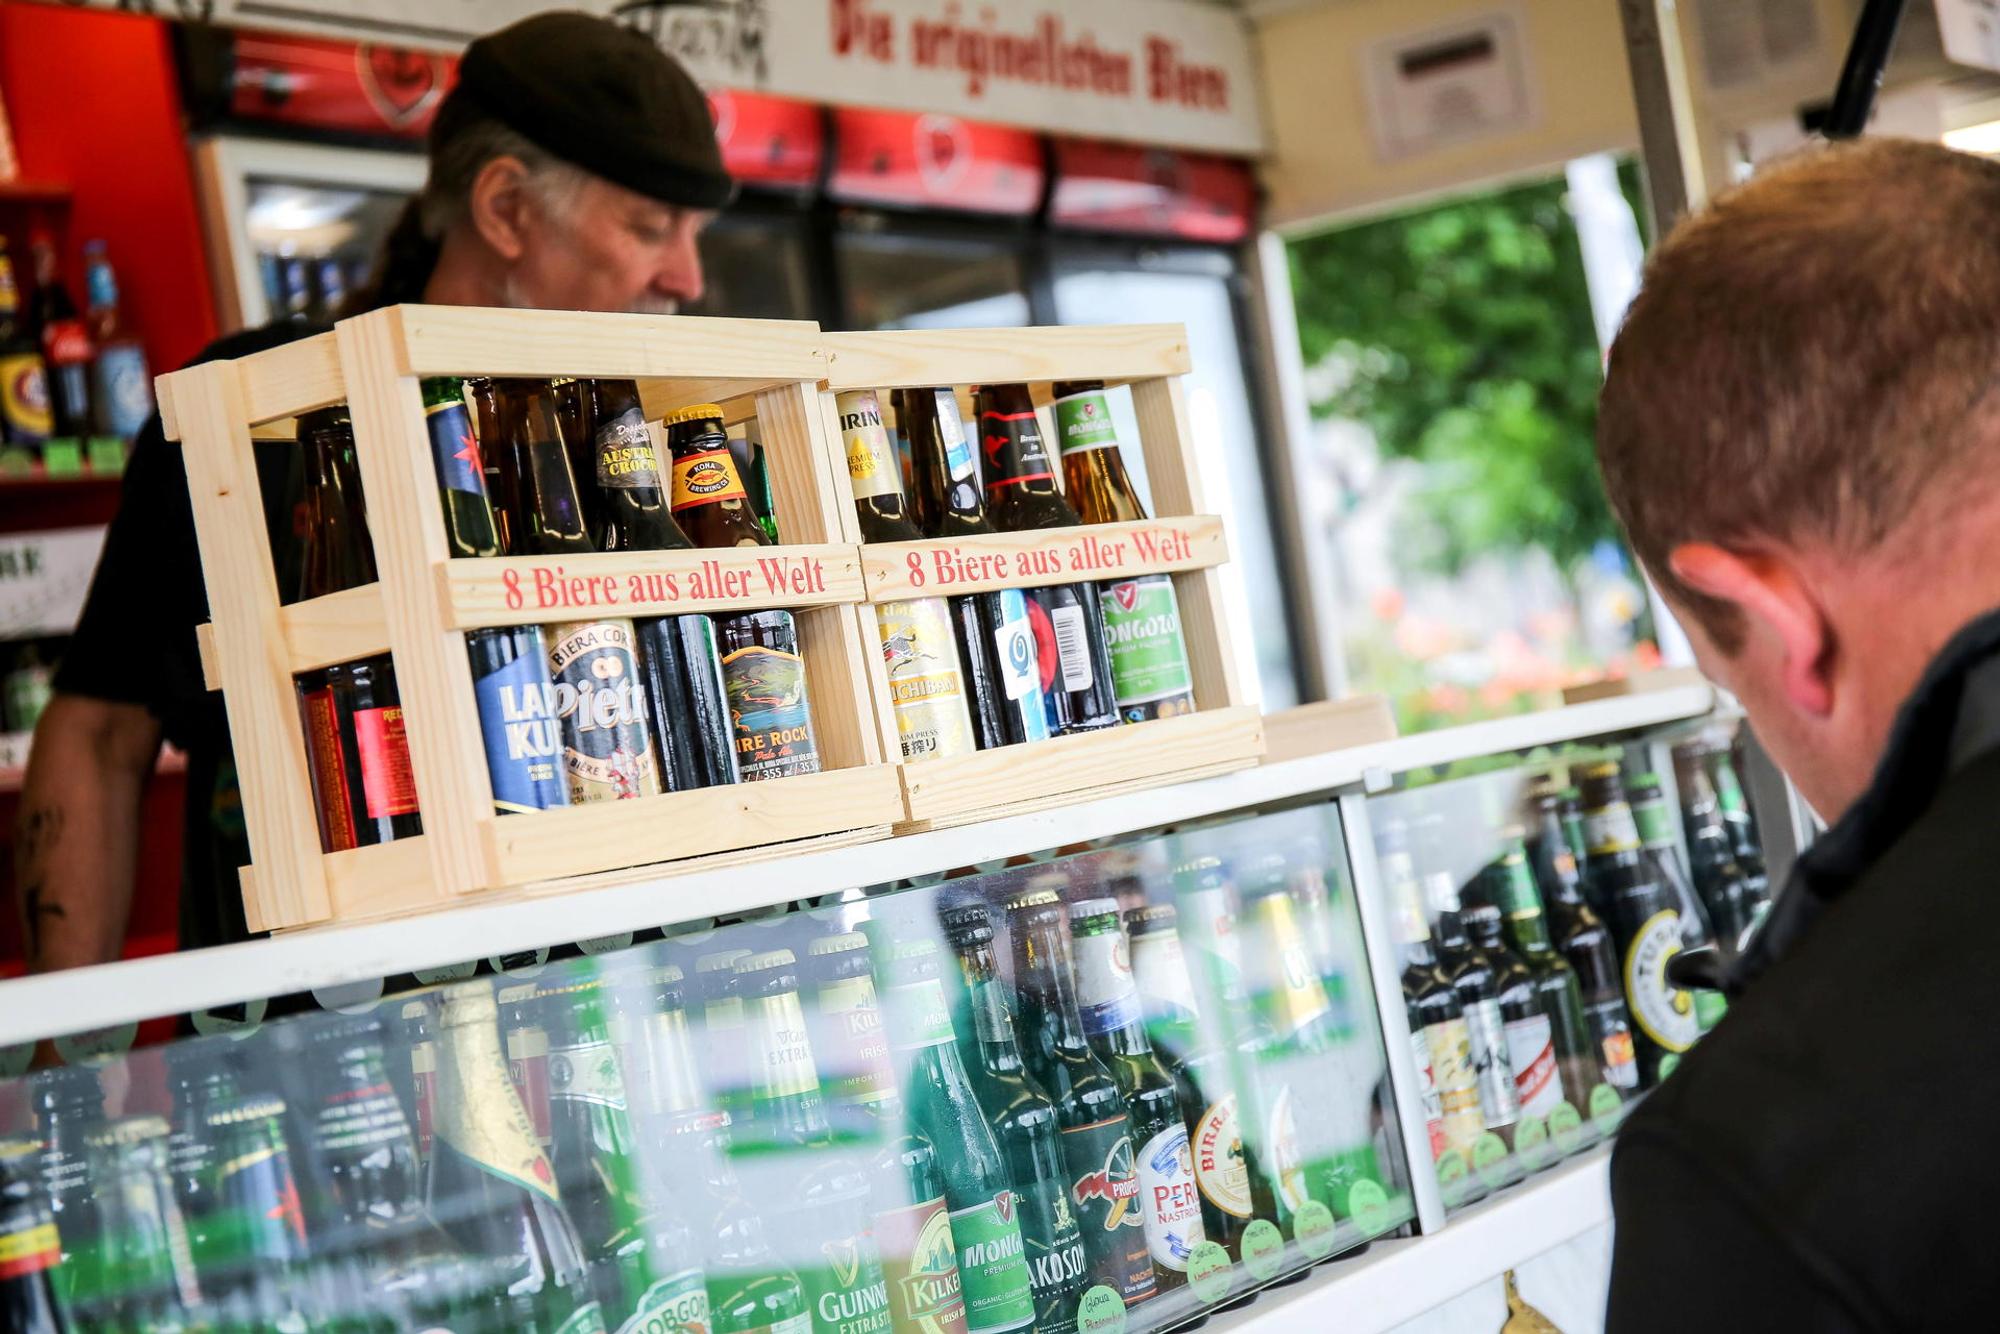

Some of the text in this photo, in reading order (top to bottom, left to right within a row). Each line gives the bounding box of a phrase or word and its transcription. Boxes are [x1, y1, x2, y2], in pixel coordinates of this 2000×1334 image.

[840, 409, 880, 433] IRIN
[694, 463, 716, 473] KONA
[691, 482, 721, 493] BREWING
[906, 529, 1193, 588] 8 Biere aus aller Welt
[502, 556, 825, 611] 8 Biere aus aller Welt
[1104, 613, 1176, 646] ONGOZO
[552, 632, 599, 666] BIERA
[735, 726, 809, 753] IRE ROCK
[901, 737, 937, 757] 番搾り
[763, 767, 783, 781] 355
[1201, 1106, 1231, 1172] BIRRA
[972, 1294, 1003, 1308] ORGANIC
[640, 1296, 708, 1334] OBGO
